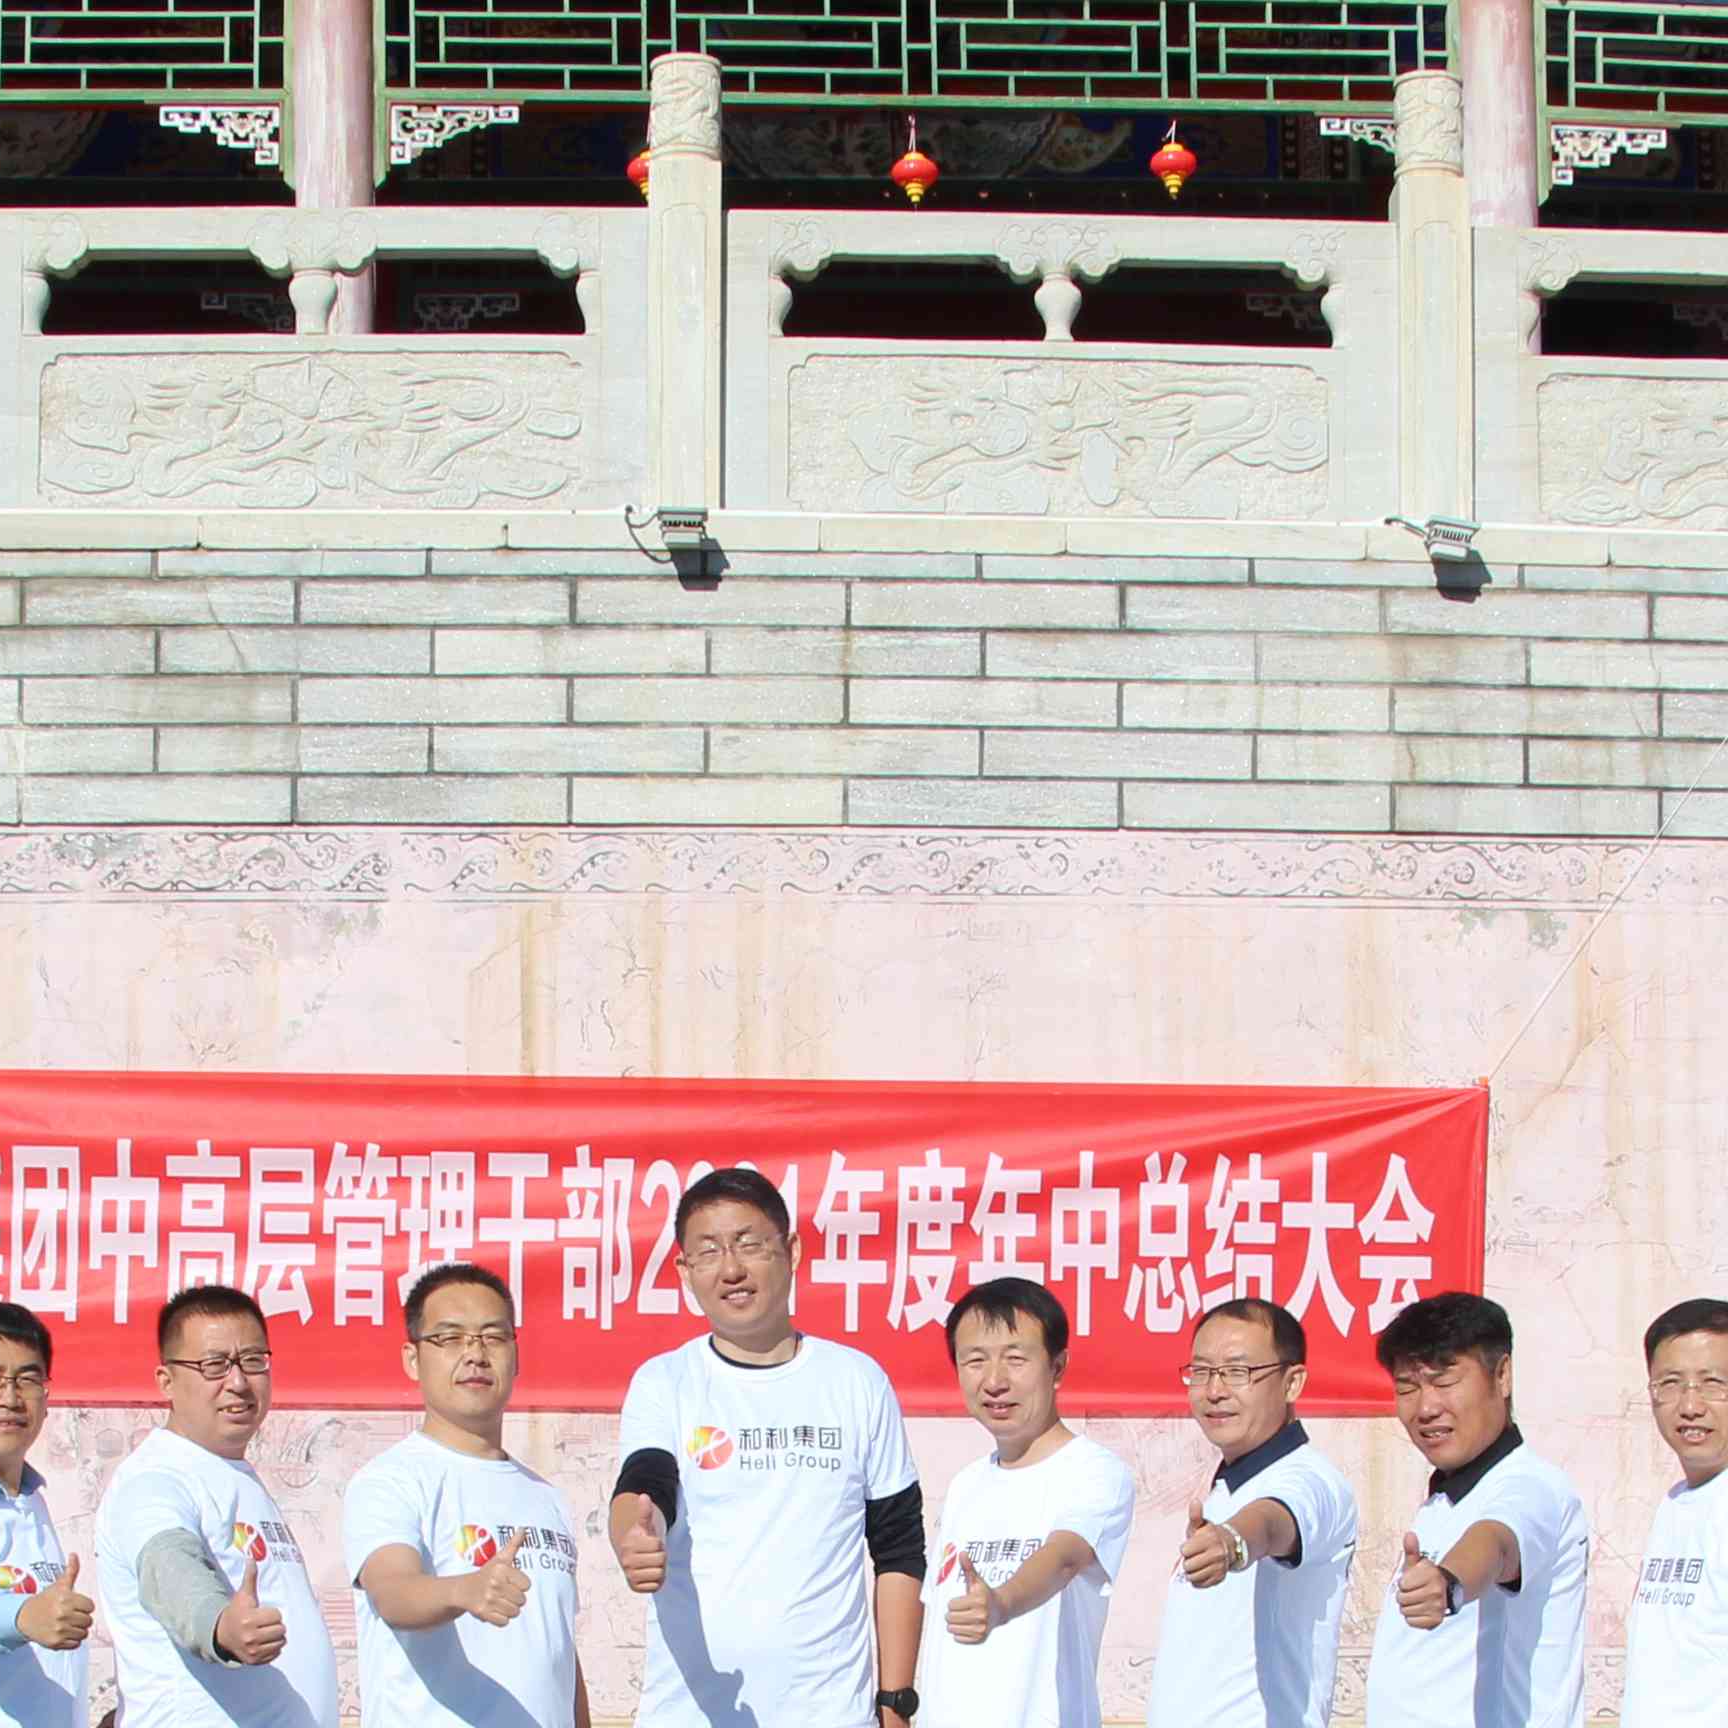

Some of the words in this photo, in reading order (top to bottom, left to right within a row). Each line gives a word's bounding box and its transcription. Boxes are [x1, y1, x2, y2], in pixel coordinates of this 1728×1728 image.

[738, 1425, 842, 1451] 和利集团
[739, 1454, 776, 1471] Heli
[784, 1452, 841, 1472] Group
[1645, 1558, 1704, 1585] 和利集团
